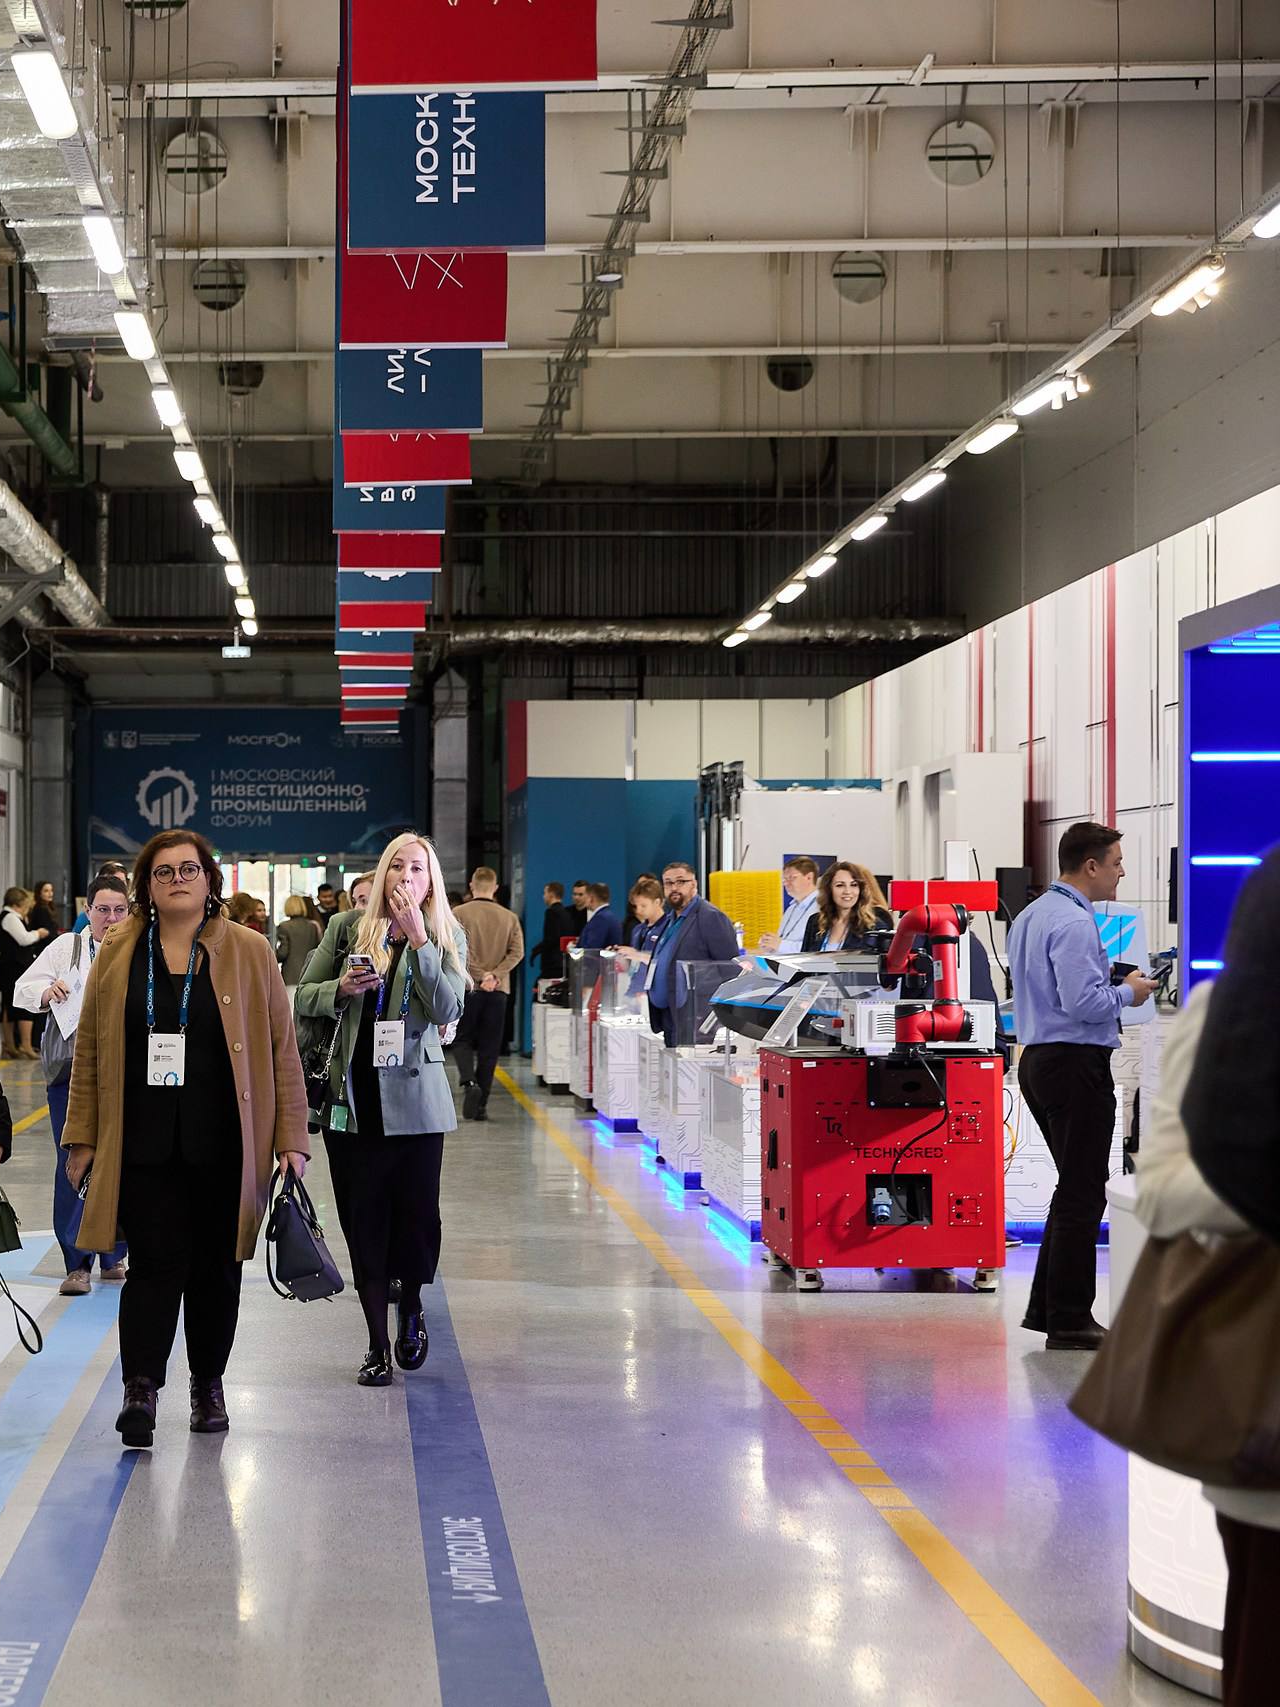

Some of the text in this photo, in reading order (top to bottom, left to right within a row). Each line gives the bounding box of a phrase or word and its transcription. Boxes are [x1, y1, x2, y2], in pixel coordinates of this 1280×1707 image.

[228, 732, 301, 748] МОСПРОМ
[221, 766, 336, 783] МОСКОВСКИЙ
[211, 784, 370, 798] ИНВЕСТИЦИОННО-
[211, 797, 367, 812] ПРОМЫШЛЕННЫЙ
[210, 814, 272, 827] ФОРУМ
[853, 1147, 943, 1159] TECHNORED
[441, 1516, 497, 1591] ЭКСПОЗИЦИЯ
